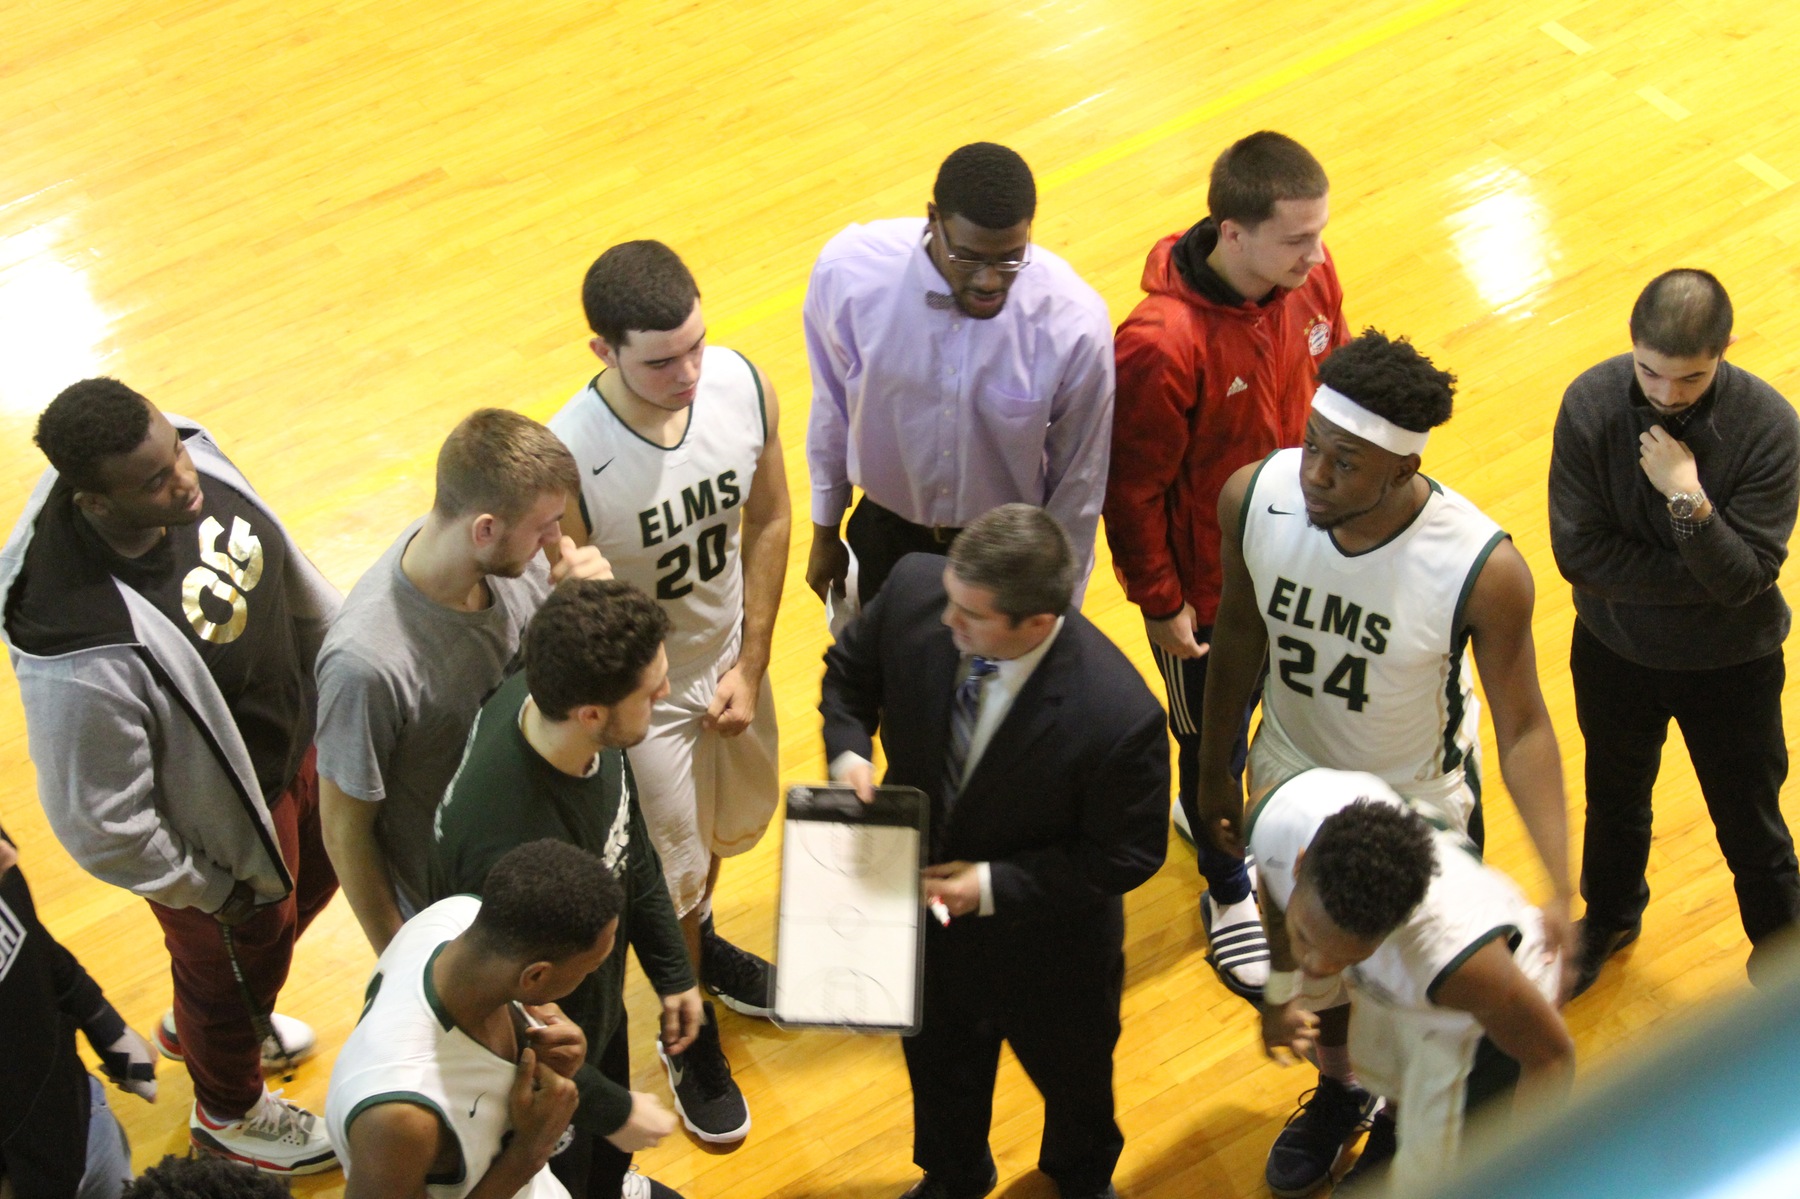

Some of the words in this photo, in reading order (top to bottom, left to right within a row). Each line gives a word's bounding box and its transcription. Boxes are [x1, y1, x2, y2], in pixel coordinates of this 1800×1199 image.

[638, 469, 741, 548] ELMS
[181, 514, 264, 645] OG
[656, 523, 727, 600] 20
[1267, 576, 1392, 655] ELMS
[1277, 635, 1370, 713] 24
